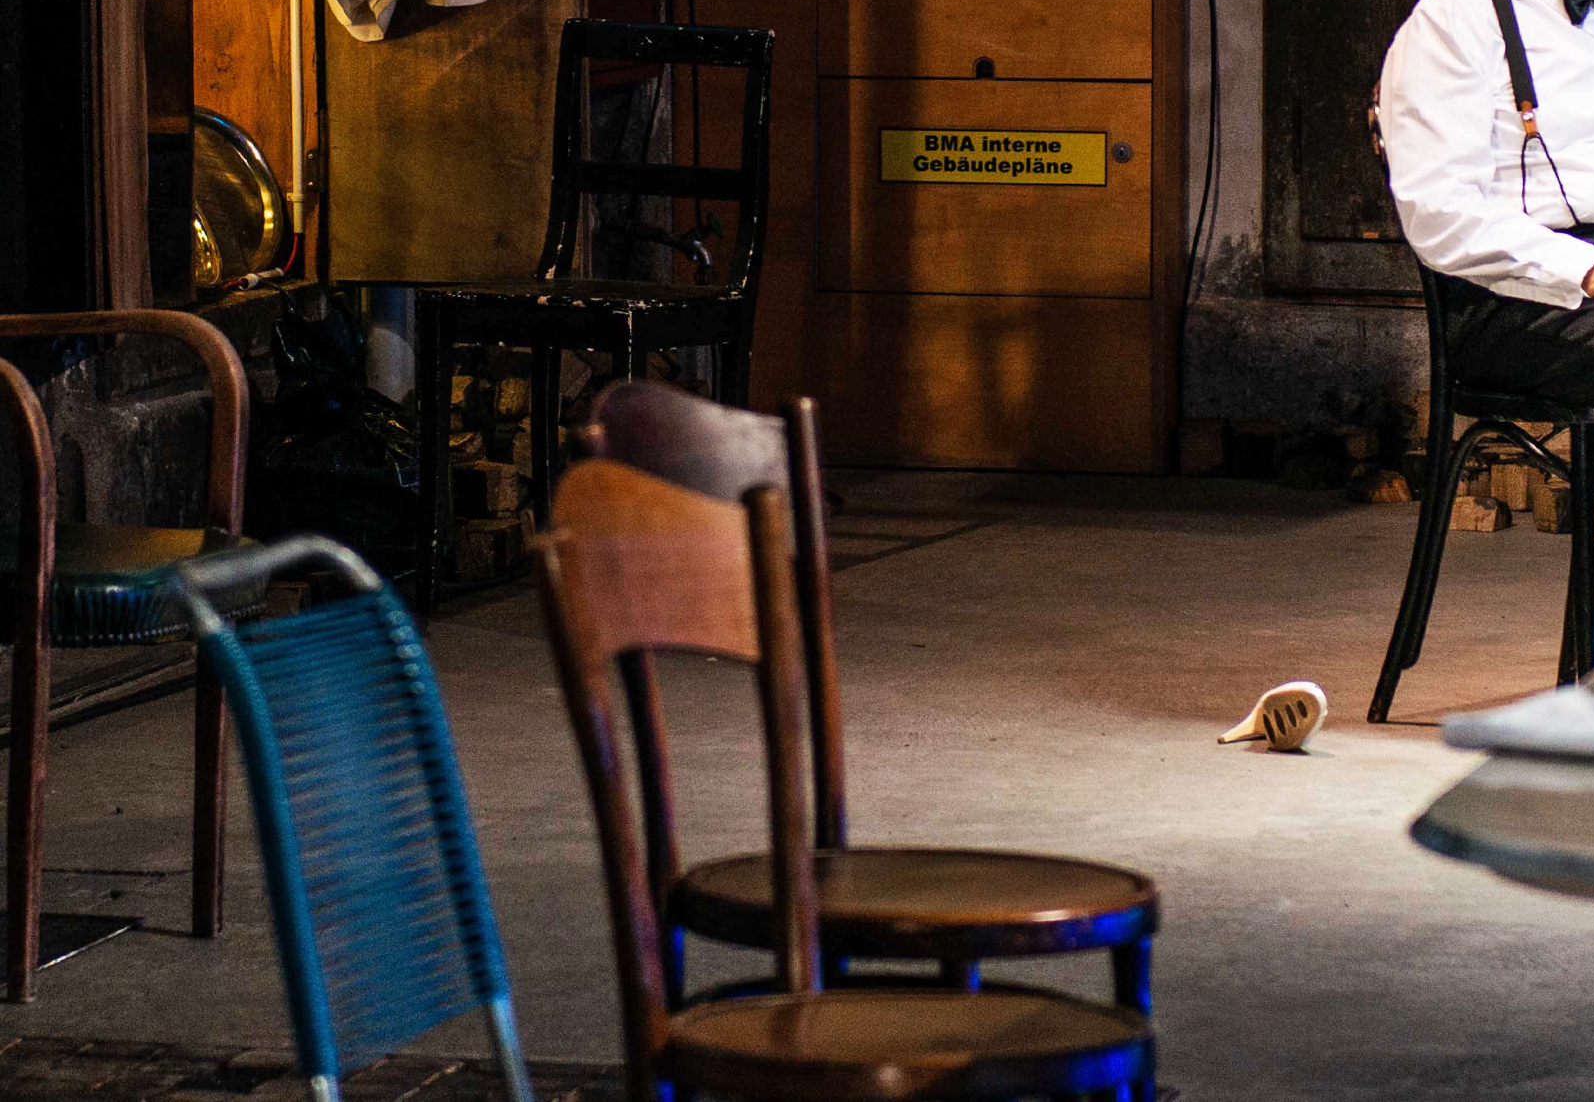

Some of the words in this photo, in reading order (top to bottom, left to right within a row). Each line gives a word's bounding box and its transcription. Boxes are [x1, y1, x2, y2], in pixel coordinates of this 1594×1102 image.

[925, 135, 975, 152] BMA
[982, 137, 1061, 153] interne
[913, 155, 1073, 177] Gebäudepläne
